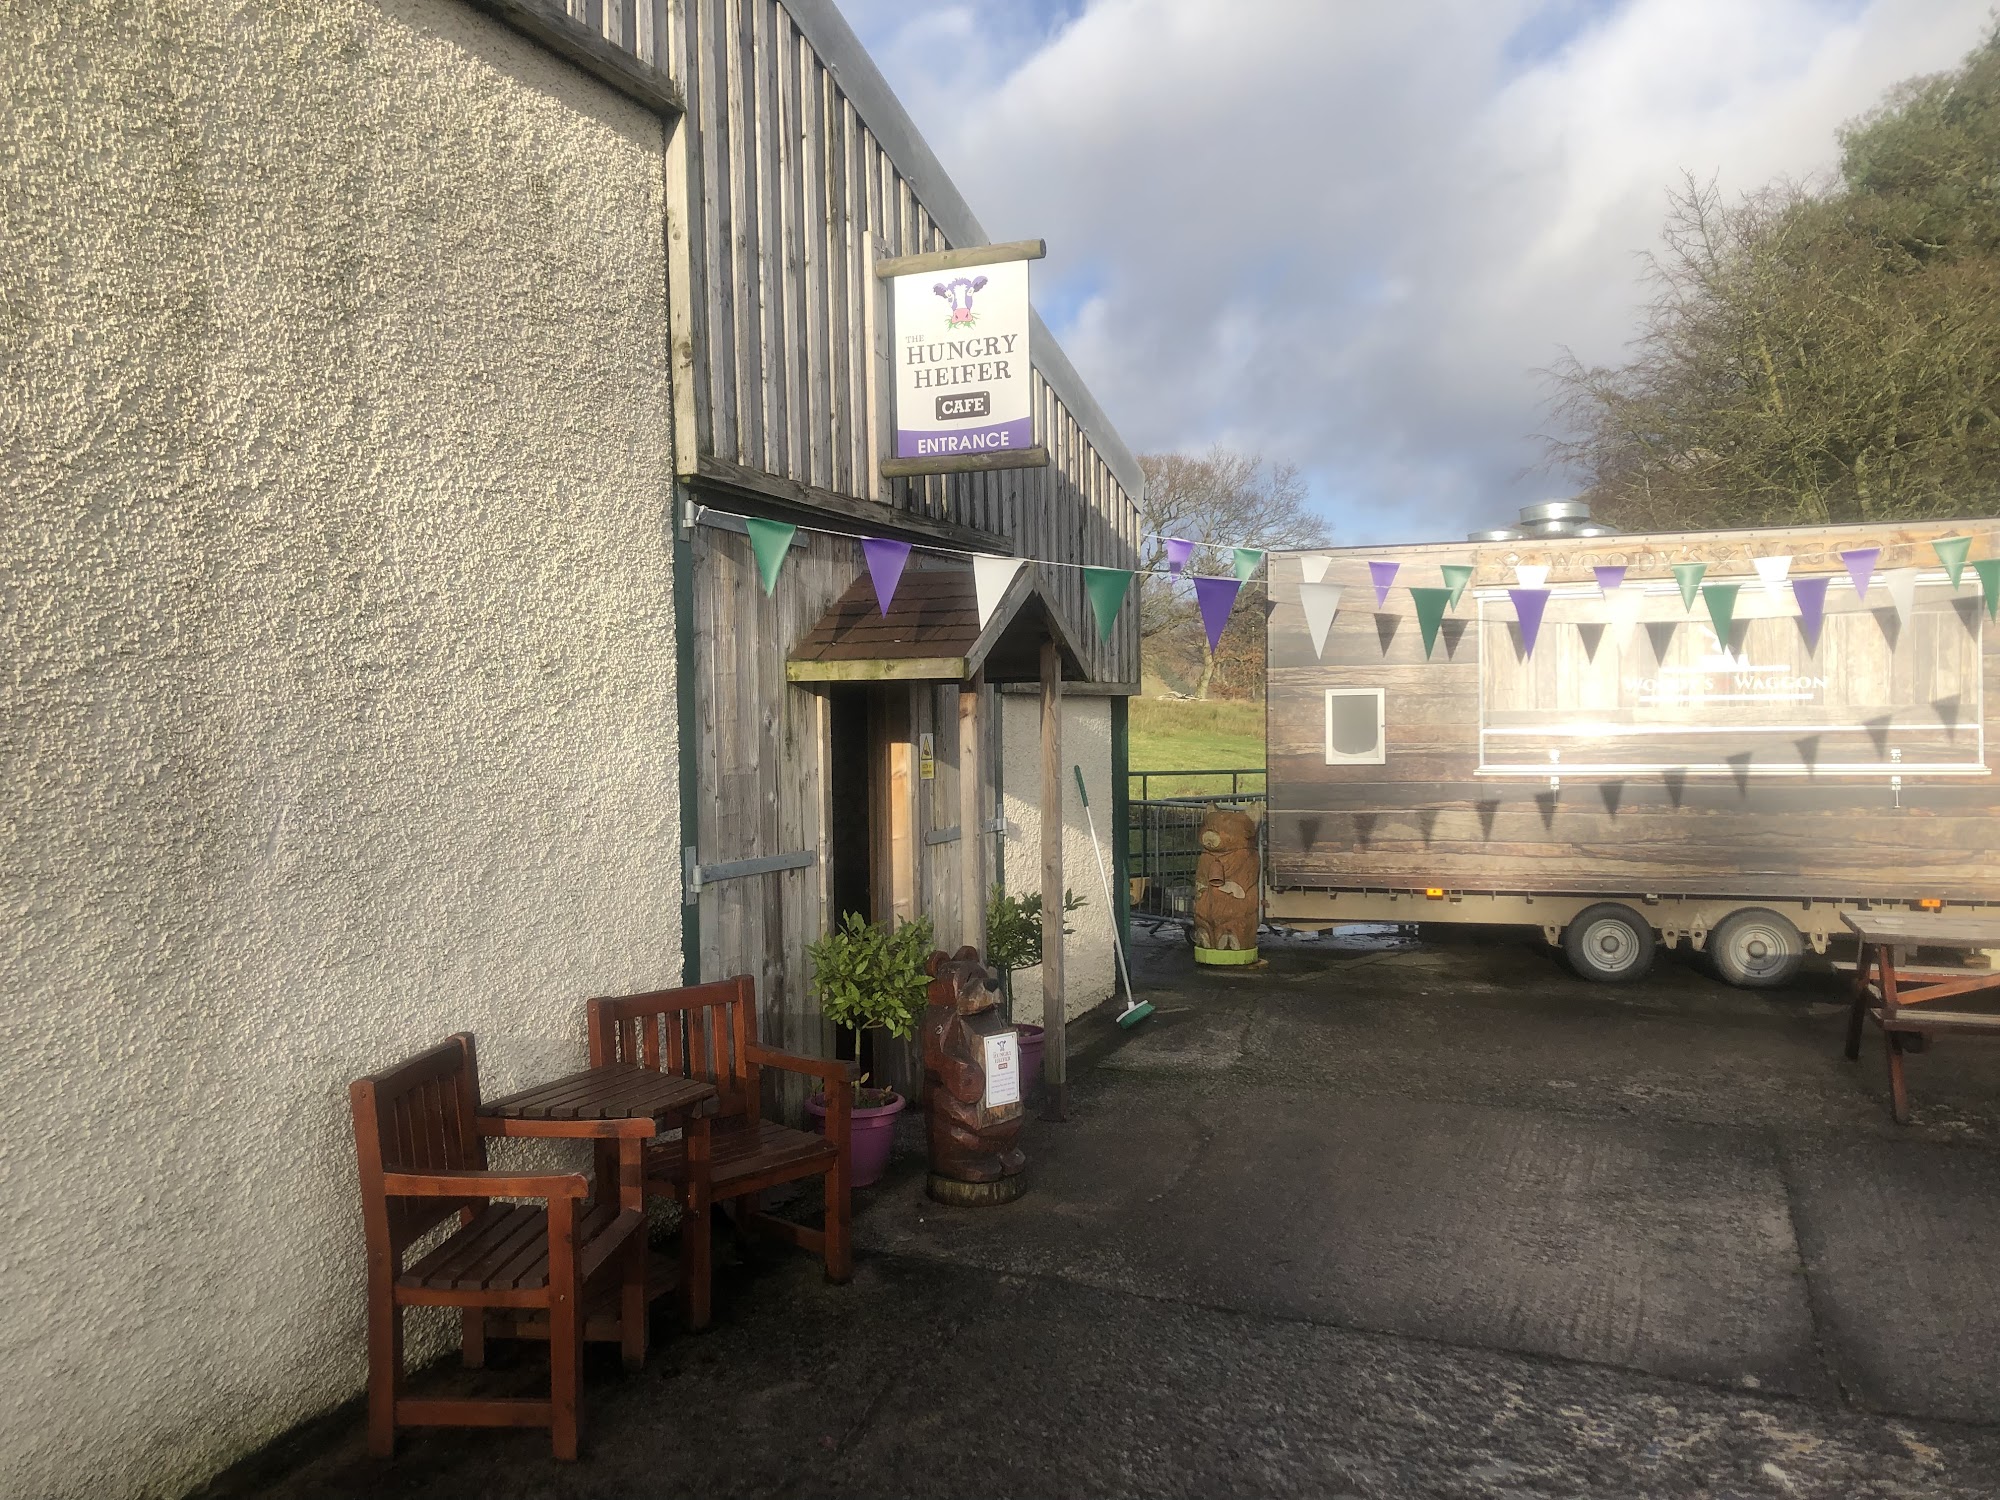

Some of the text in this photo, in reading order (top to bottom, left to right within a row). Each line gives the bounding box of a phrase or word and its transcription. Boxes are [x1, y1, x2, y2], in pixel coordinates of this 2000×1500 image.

[906, 334, 925, 343] THE
[906, 334, 1017, 365] HUNGRY
[914, 361, 1011, 388] HEIFER
[942, 398, 984, 414] CAFE
[918, 431, 1009, 454] ENTRANCE
[1543, 538, 1913, 574] WOODY'S WAGGON
[1622, 673, 1828, 691] WOY'S WAGGON
